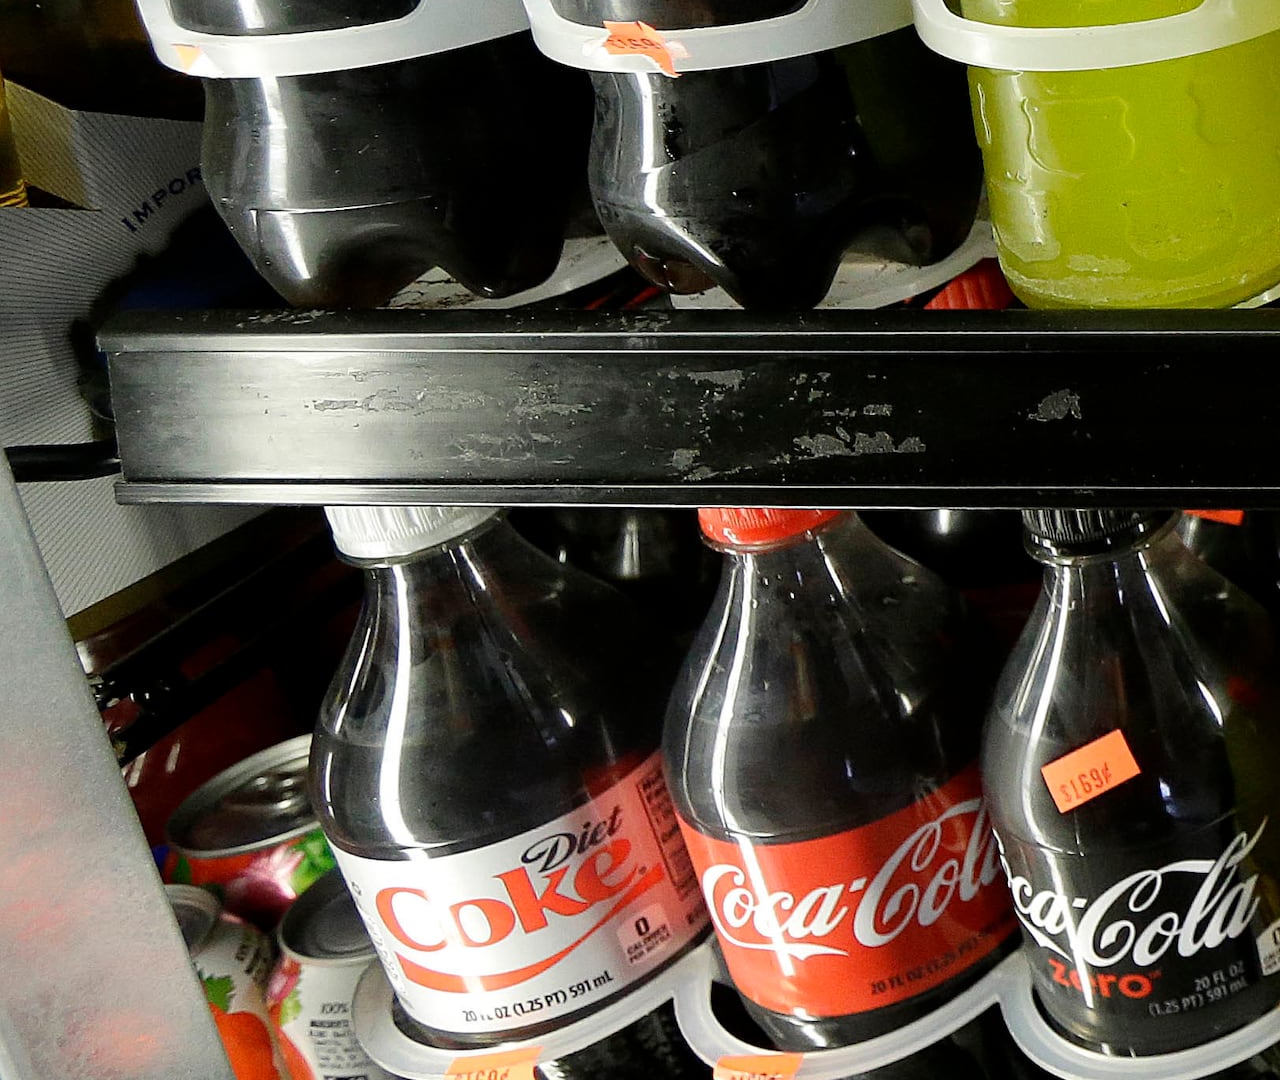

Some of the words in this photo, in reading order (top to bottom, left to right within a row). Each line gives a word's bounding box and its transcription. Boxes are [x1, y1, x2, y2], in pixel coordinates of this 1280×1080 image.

[521, 805, 624, 875] Diet
[375, 838, 639, 953] Coke
[634, 916, 651, 937] 0
[460, 1008, 479, 1023] 20
[495, 1005, 511, 1020] OZ
[544, 990, 568, 1013] PT)
[568, 979, 593, 1000] 591
[591, 970, 615, 993] mL
[1194, 976, 1210, 993] 20
[1211, 969, 1227, 987] FL
[1227, 959, 1247, 979] OZ
[1181, 991, 1204, 1012] PT)
[1205, 984, 1229, 1004] 591
